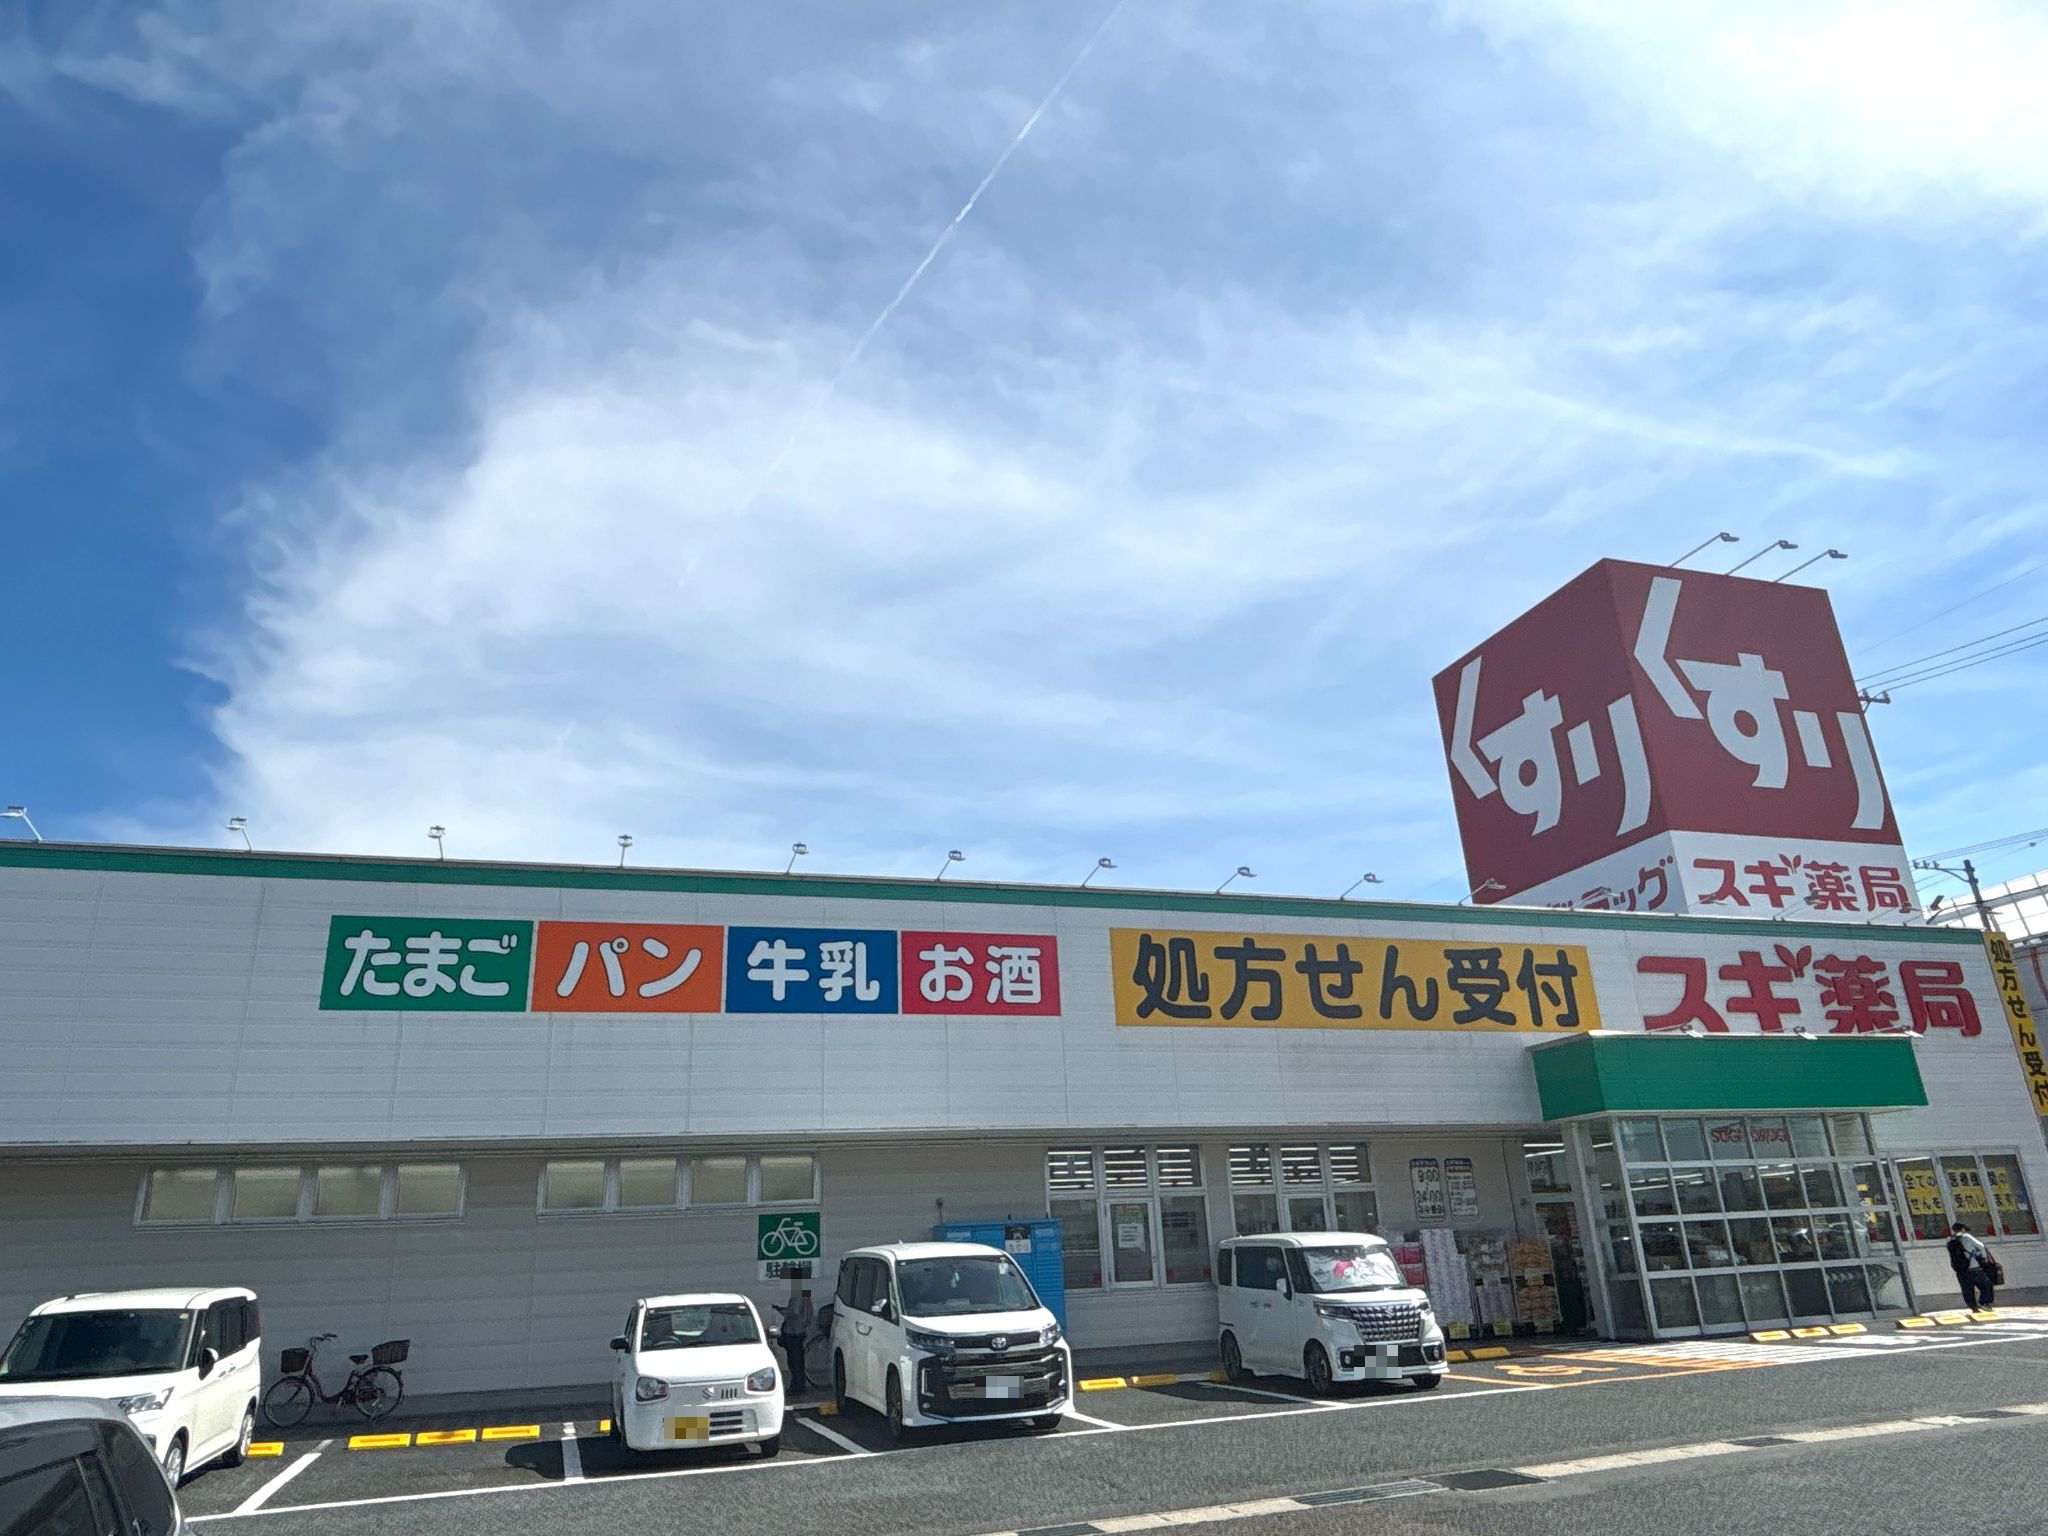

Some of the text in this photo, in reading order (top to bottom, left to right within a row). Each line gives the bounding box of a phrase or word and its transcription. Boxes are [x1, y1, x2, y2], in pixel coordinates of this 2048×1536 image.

[1634, 576, 1884, 830] くすり
[1451, 656, 1651, 836] くすり
[1547, 856, 1673, 910] ラッグ
[1693, 853, 1909, 913] スギ薬局
[339, 929, 518, 998] たまご
[557, 937, 701, 998] パン
[747, 939, 880, 1002] 牛乳
[919, 943, 1042, 1004] お酒
[1133, 933, 1578, 1027] 処方せん受付
[1637, 944, 1982, 1037] スギ薬局
